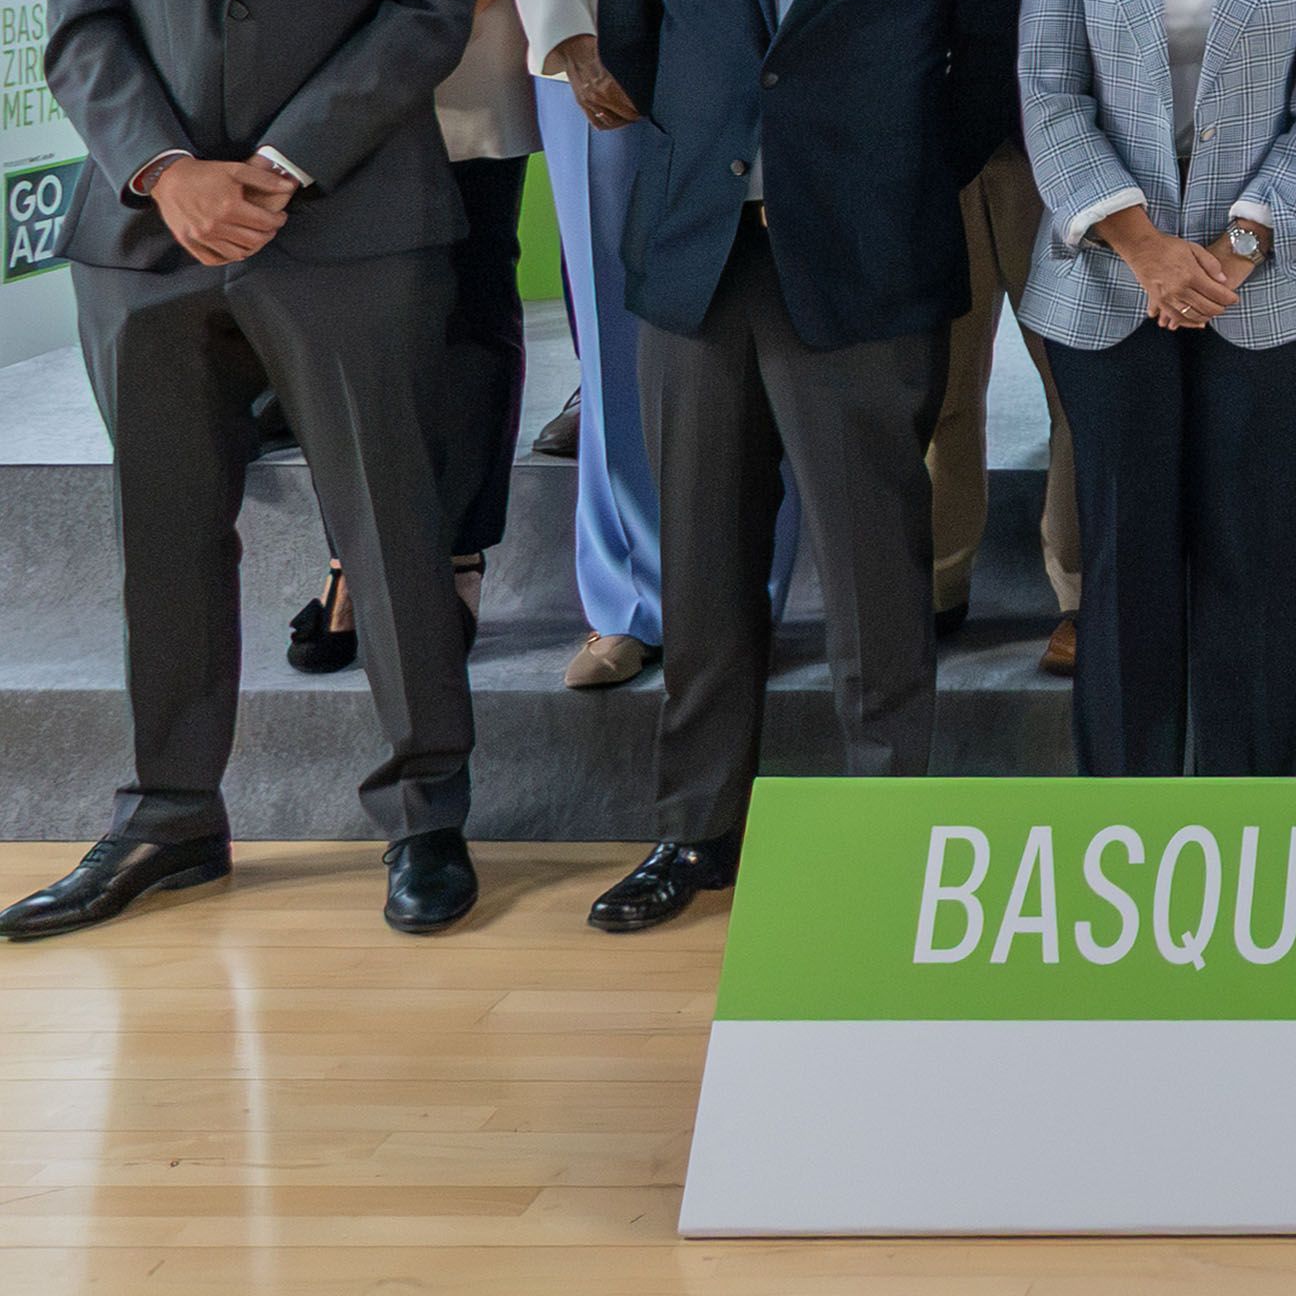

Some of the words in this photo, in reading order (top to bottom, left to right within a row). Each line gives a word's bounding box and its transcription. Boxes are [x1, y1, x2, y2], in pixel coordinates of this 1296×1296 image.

[3, 3, 44, 46] BAS
[3, 86, 67, 131] META
[10, 174, 63, 222] GO
